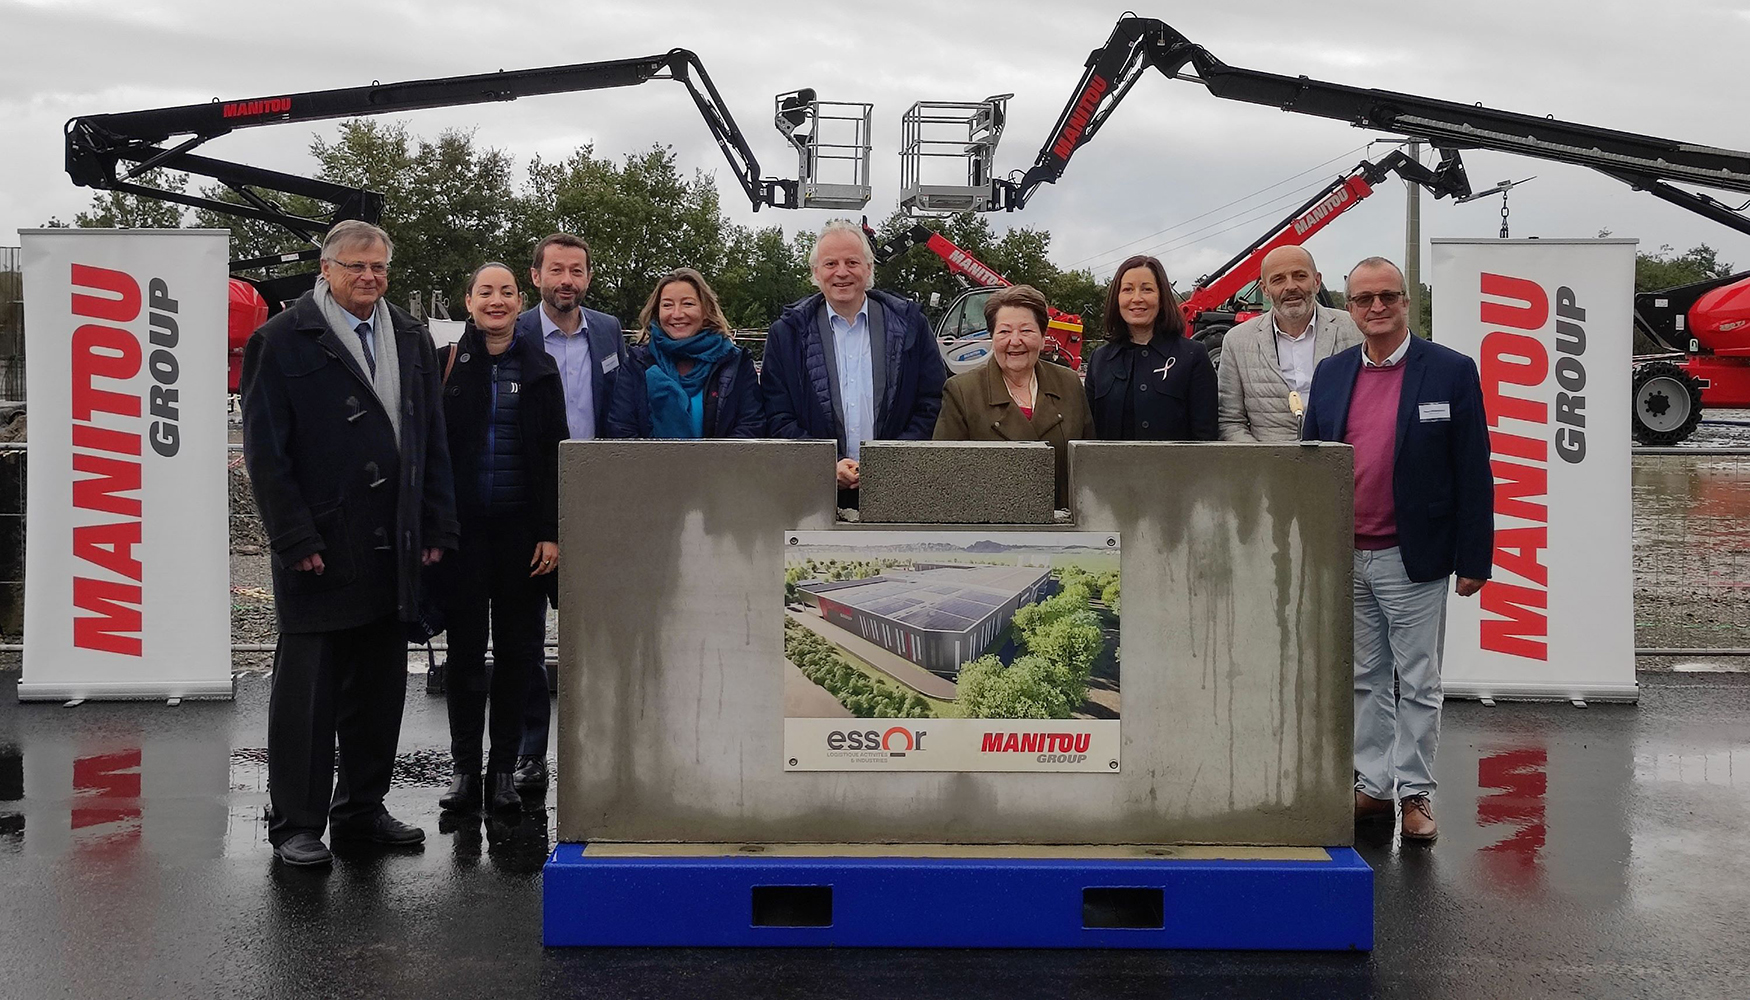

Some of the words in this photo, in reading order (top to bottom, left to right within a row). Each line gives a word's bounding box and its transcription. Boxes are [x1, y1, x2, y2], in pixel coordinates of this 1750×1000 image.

[223, 98, 292, 118] MANITOU
[1053, 74, 1107, 160] MANITOU
[1294, 188, 1349, 236] MANITOU
[148, 277, 180, 458] GROUP
[1555, 285, 1588, 464] GROUP
[71, 263, 143, 657] MANITOU
[1480, 272, 1549, 661] MANITOU
[981, 732, 1091, 753] MANITOU
[1036, 754, 1088, 764] GROUP
